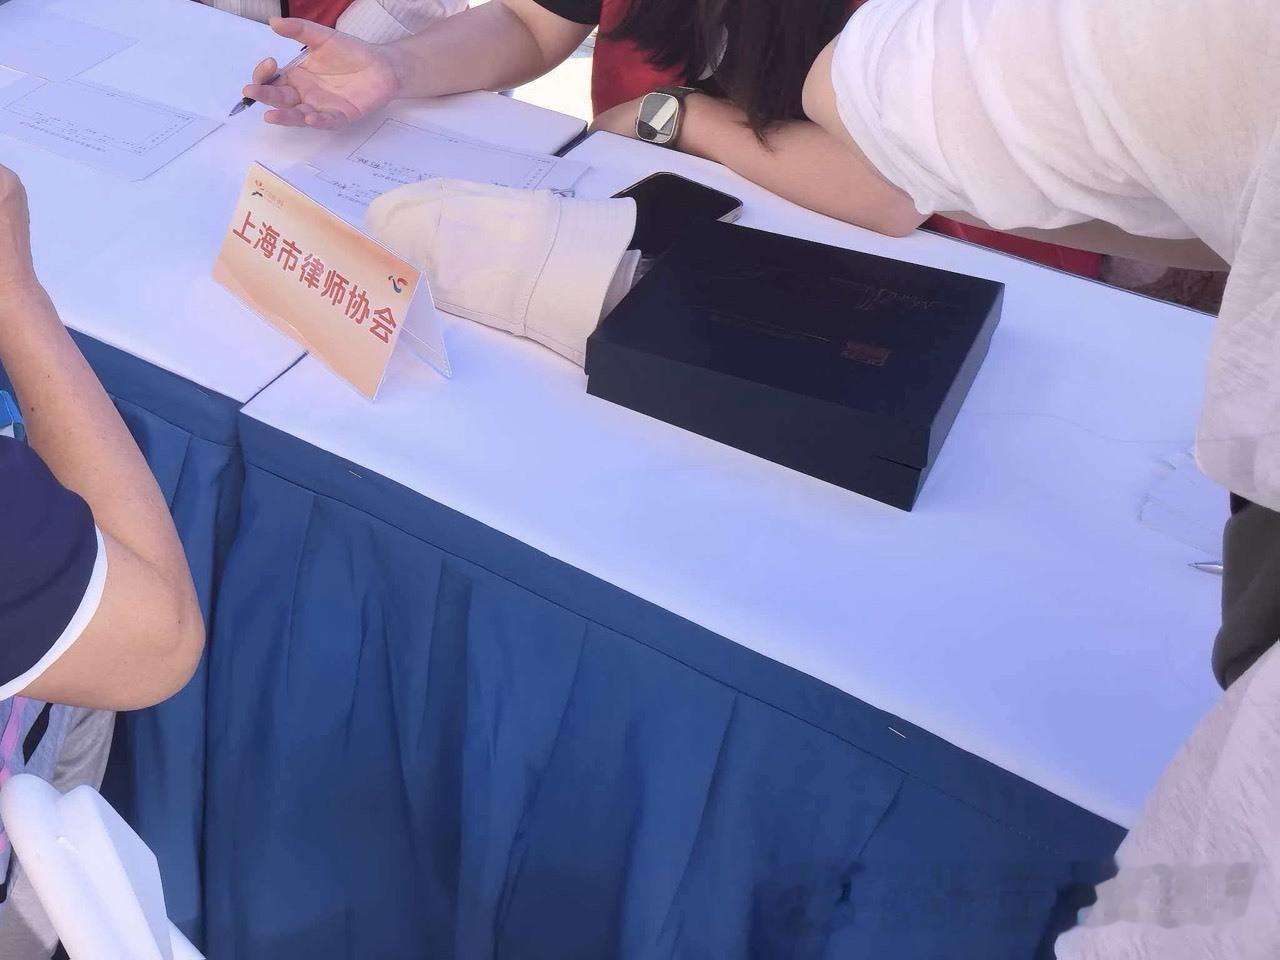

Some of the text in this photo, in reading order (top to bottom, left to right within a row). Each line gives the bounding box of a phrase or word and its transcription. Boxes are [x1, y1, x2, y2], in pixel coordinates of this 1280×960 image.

[233, 211, 396, 343] 上海市律师协会
